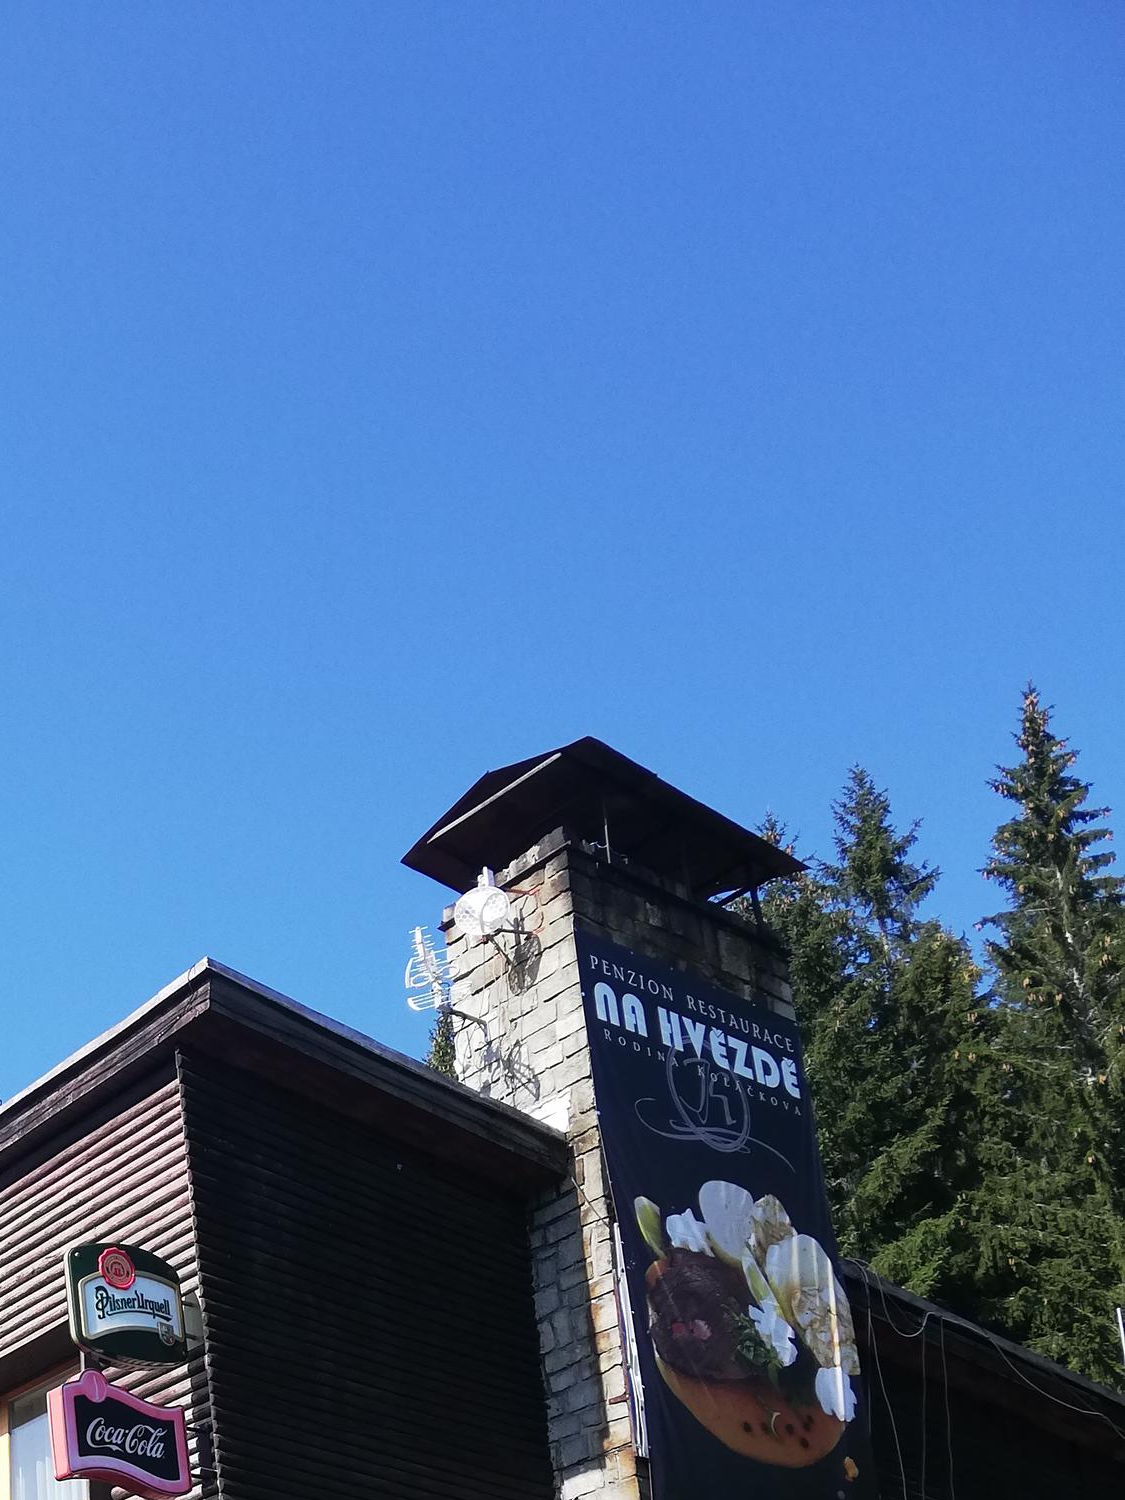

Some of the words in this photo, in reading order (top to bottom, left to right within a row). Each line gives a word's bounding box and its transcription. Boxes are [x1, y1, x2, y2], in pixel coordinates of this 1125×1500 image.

[589, 954, 674, 1002] PENZION
[686, 994, 795, 1053] RESTAURACE
[593, 981, 648, 1038] NA
[603, 1029, 679, 1068] RODINA
[95, 1285, 136, 1319] Pilsner
[135, 1290, 172, 1319] Urquell
[86, 1416, 167, 1460] Coca-Cola
